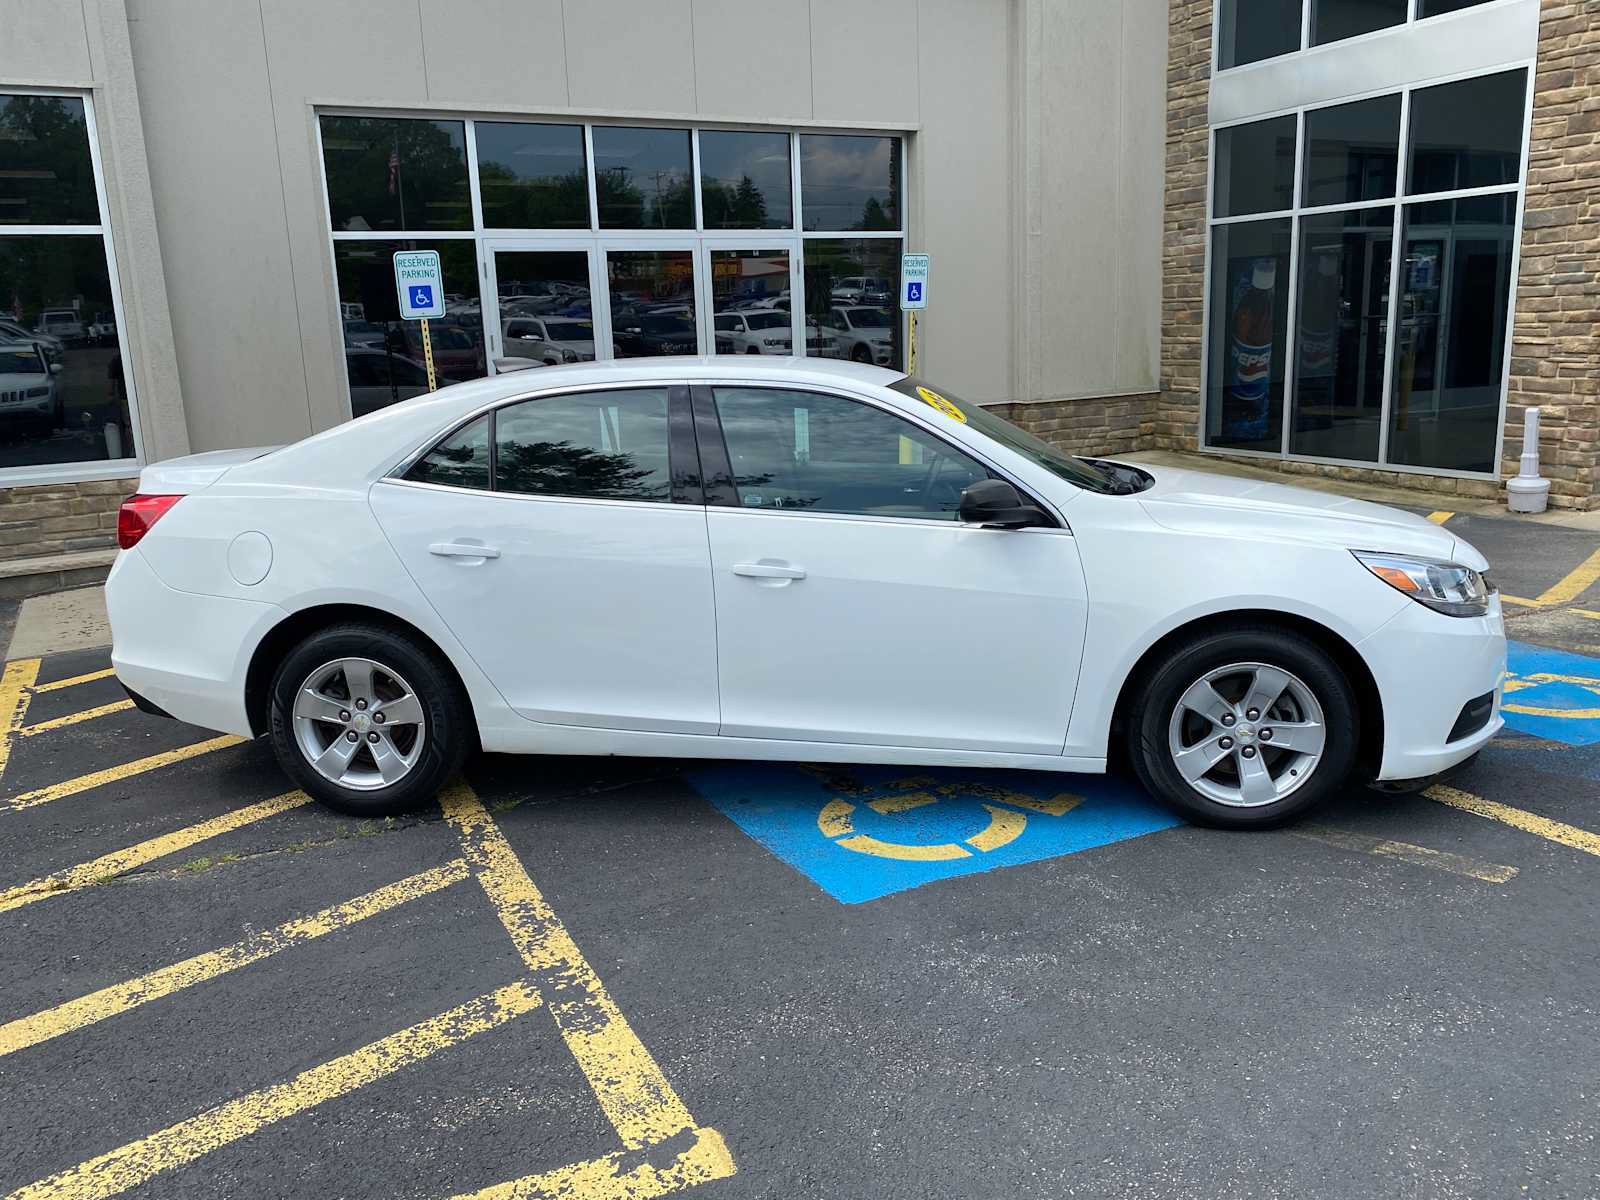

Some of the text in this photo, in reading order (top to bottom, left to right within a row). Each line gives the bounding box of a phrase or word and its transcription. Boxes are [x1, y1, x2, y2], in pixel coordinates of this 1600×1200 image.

[397, 258, 436, 268] RESERVED
[904, 259, 928, 267] RESERVED
[401, 270, 435, 279] PARKING
[905, 269, 926, 277] PARKING
